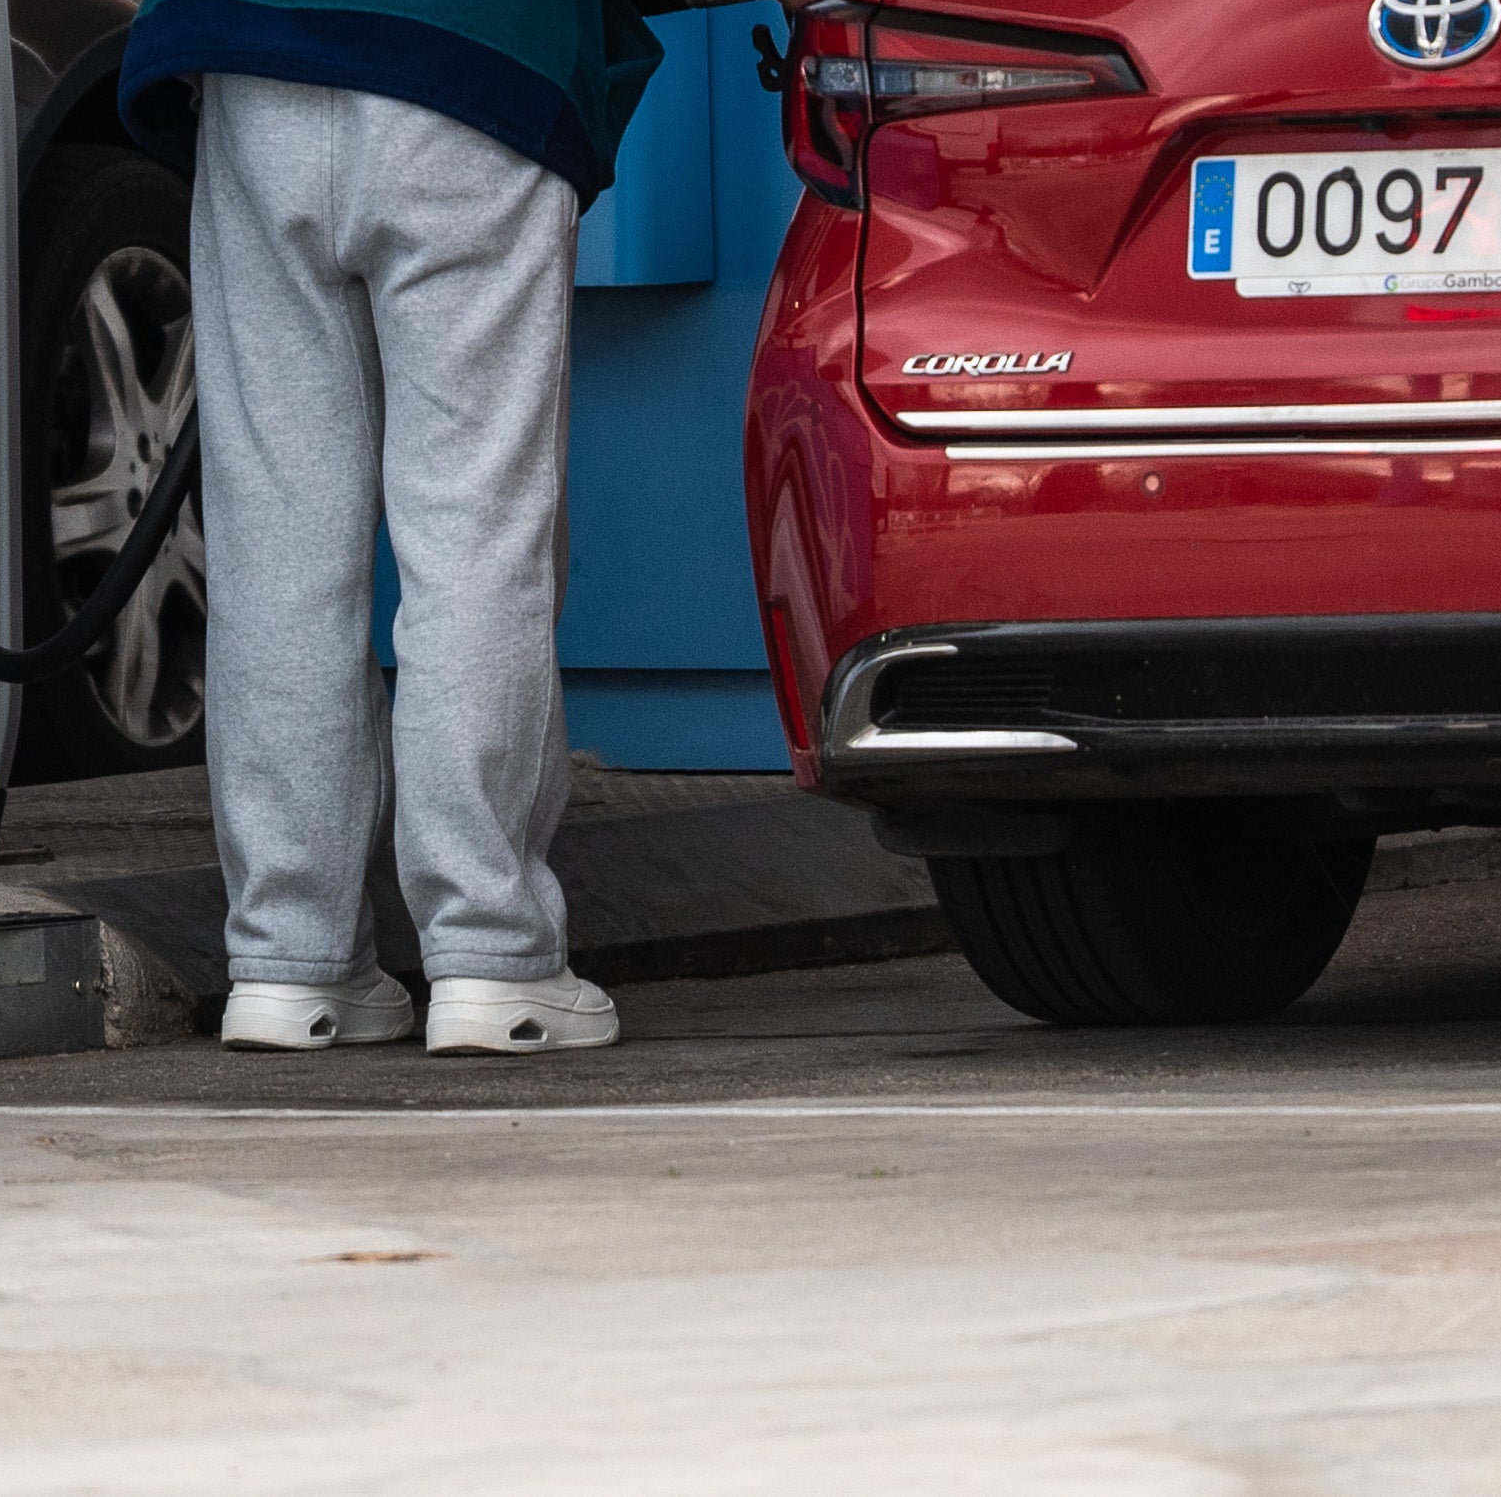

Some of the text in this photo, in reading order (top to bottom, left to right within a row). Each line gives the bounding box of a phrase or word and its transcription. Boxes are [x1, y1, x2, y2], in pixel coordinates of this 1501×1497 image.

[1257, 165, 1484, 258] 0097
[1204, 229, 1221, 255] E
[902, 350, 1072, 376] COROLLA
